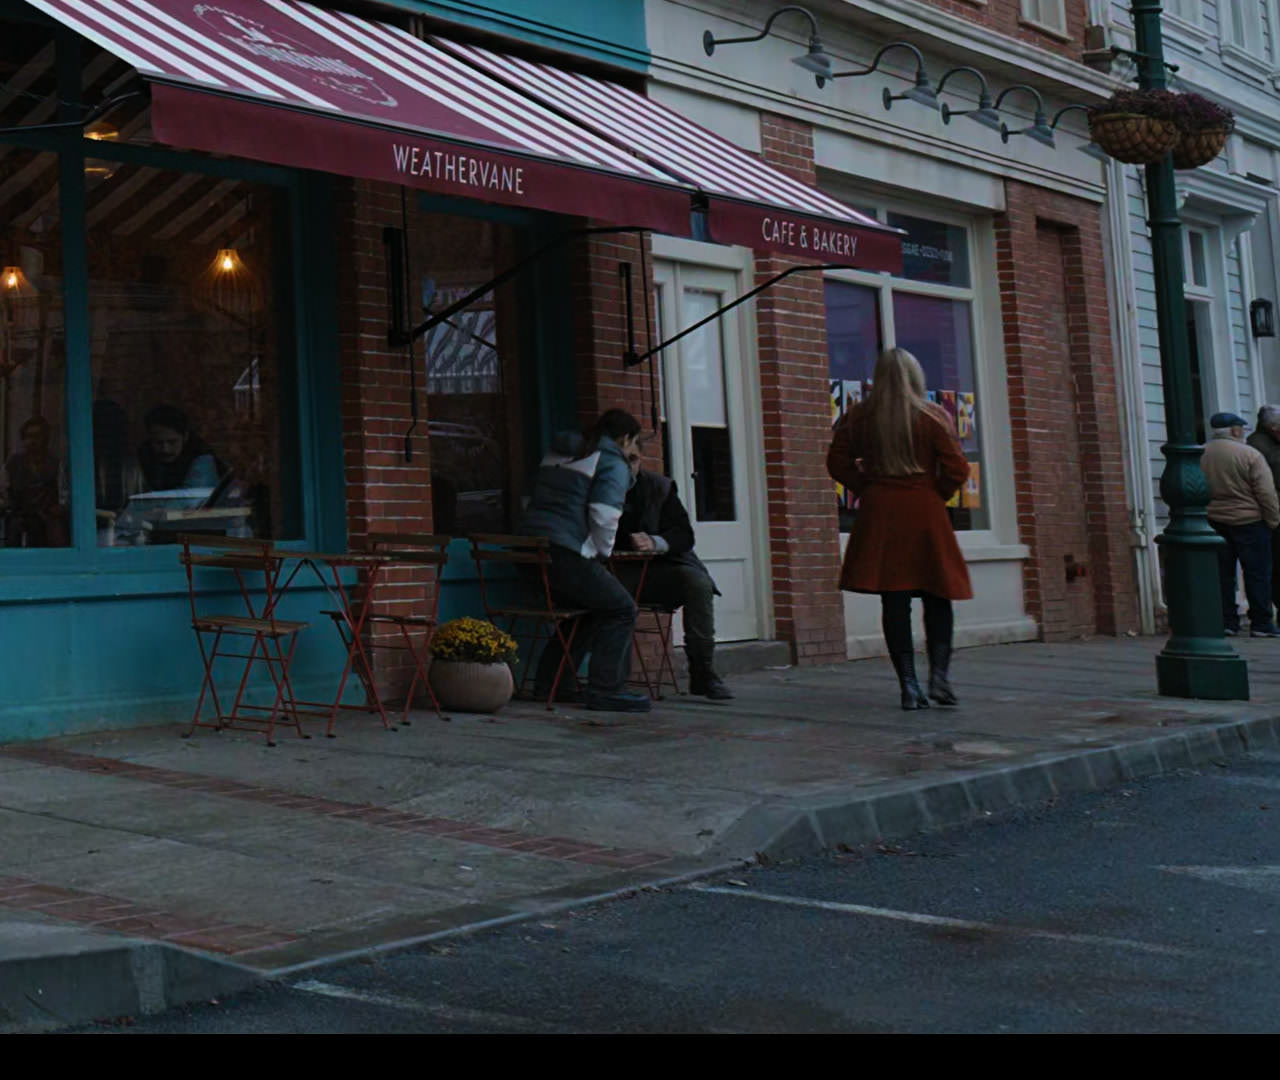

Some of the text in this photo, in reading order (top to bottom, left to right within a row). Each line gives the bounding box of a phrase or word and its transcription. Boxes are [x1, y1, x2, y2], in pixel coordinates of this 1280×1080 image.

[393, 143, 524, 195] WEATHERVANE
[761, 217, 858, 256] CAFE & BAKERY
